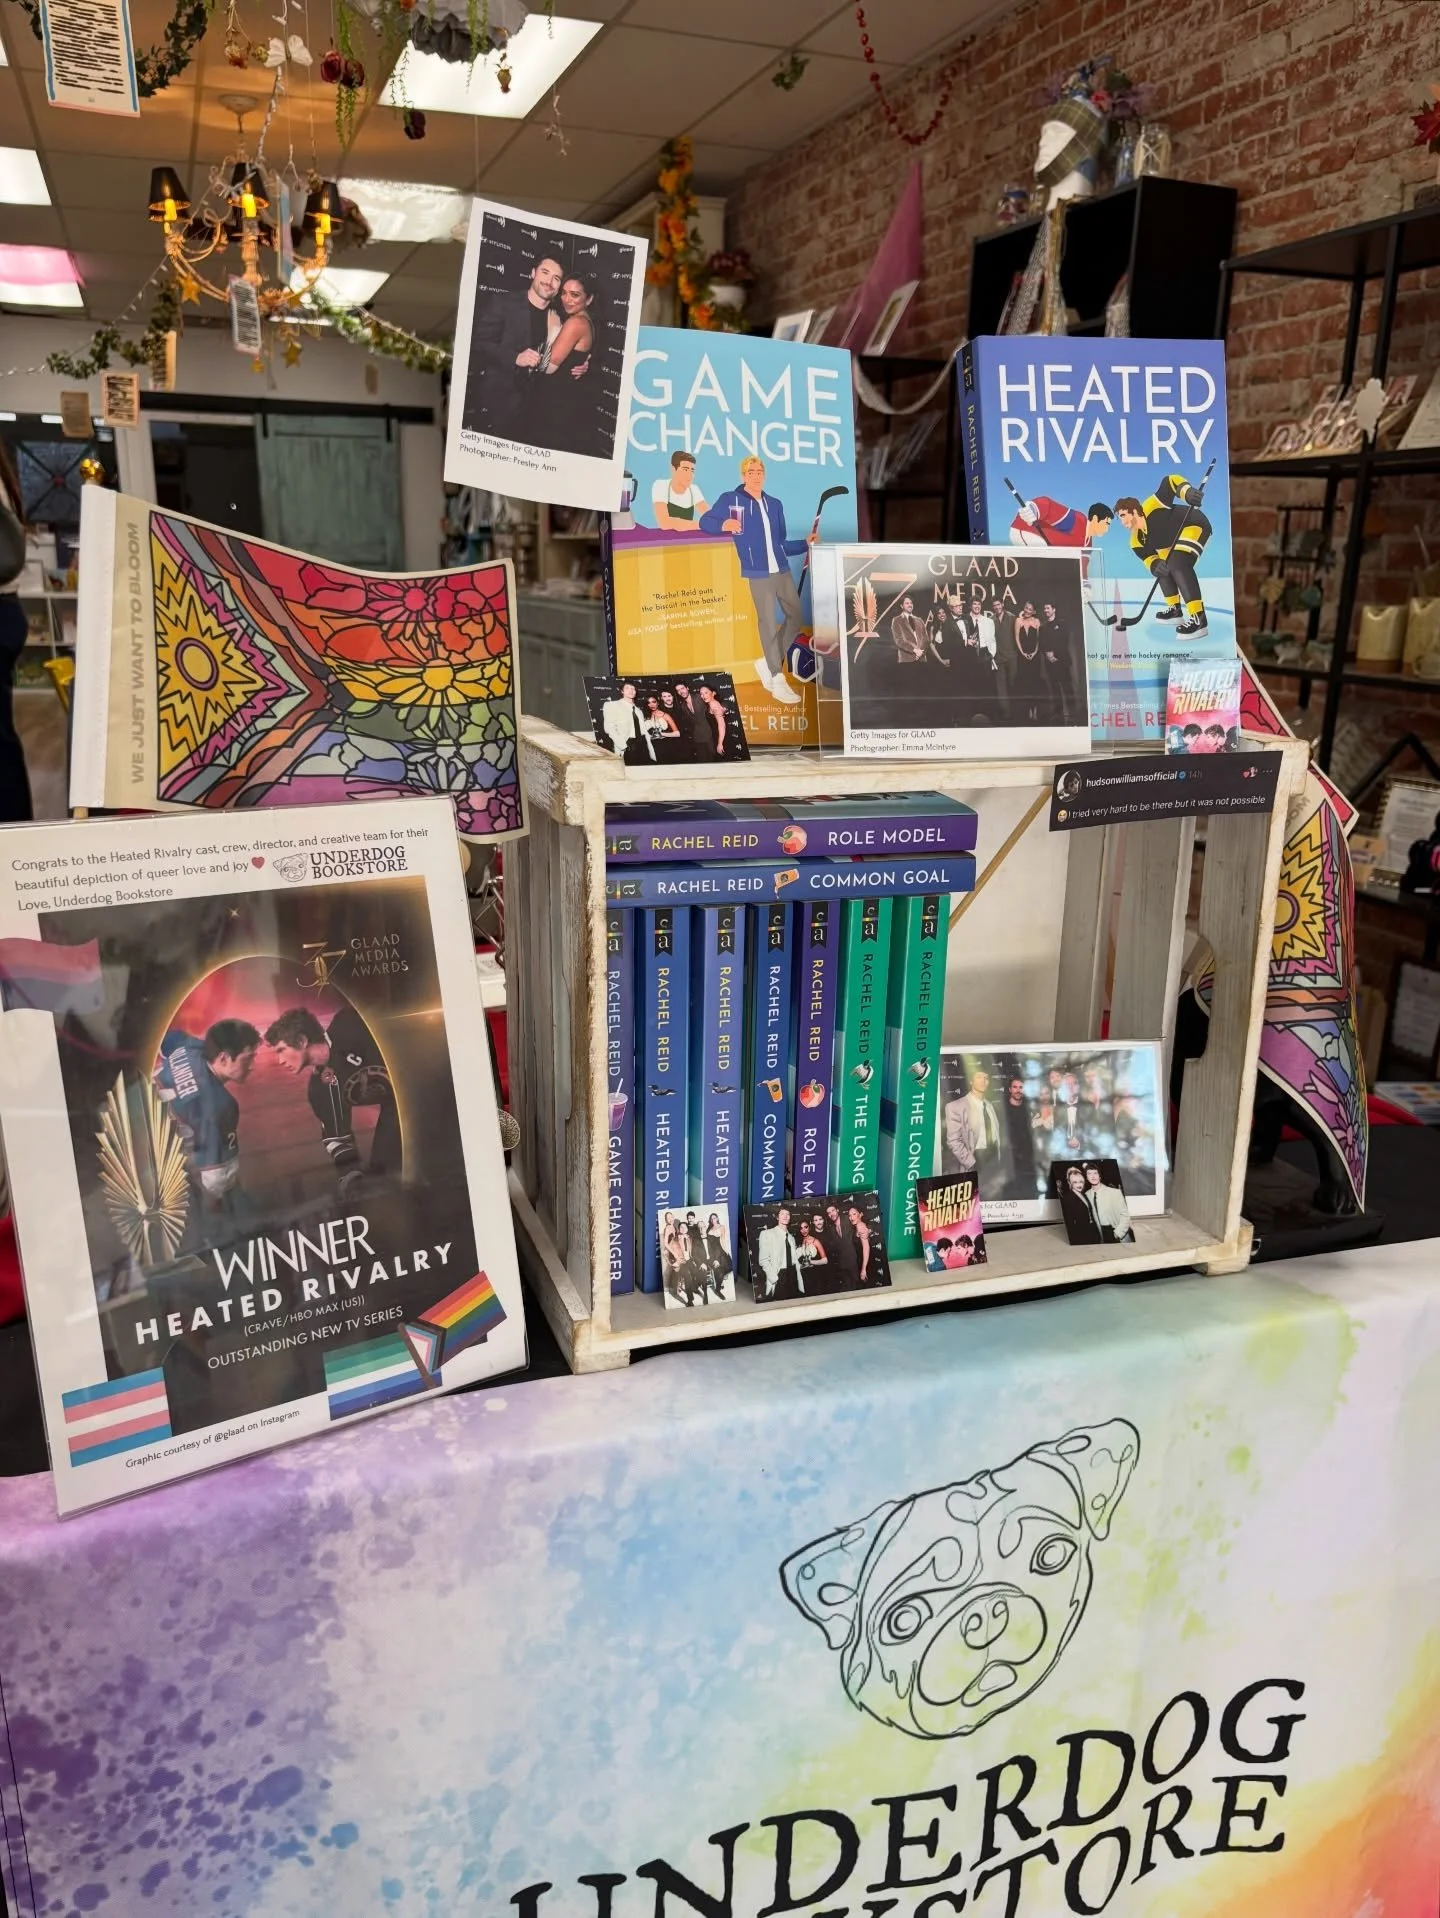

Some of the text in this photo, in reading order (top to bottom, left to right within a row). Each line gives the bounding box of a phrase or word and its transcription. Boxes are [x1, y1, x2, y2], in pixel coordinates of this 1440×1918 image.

[631, 349, 842, 424] GAME
[999, 364, 1217, 414] HEATED
[460, 431, 551, 458] Getty Images for GLAAD
[628, 411, 845, 467] CHANGER
[1001, 417, 1216, 465] RIVALRY
[459, 444, 557, 472] Photographer: Presley Ann
[968, 405, 981, 514] RACHEL REID
[928, 555, 1019, 578] GLAAD
[681, 588, 697, 598] Reid
[128, 522, 145, 785] WE JUST WANT TO BLOOM
[1139, 651, 1160, 660] hockey
[745, 704, 782, 714] Bestselling
[768, 715, 809, 731] REID
[850, 730, 937, 740] Getty Images for GLAAD
[902, 743, 924, 752] Emma
[1086, 770, 1178, 788] hudsonwilliamsofficial
[1073, 807, 1090, 819] tried
[1091, 806, 1108, 819] very
[1109, 803, 1128, 814] hard
[1130, 804, 1138, 813] to
[1140, 801, 1151, 811] be
[1152, 799, 1174, 811] there
[1175, 798, 1189, 808] but
[1190, 797, 1196, 808] it
[1198, 798, 1214, 806] was
[1216, 795, 1229, 806] not
[1231, 795, 1266, 807] possible
[12, 828, 429, 872] Congrats to the Heated Rivalry cast, crew, director, and creative team for their
[310, 845, 406, 866] UNDERDOG
[651, 836, 715, 851] RACHEL
[721, 833, 759, 849] REID
[828, 830, 875, 846] ROLE
[882, 827, 947, 844] MODEL
[15, 875, 69, 892] beautiful
[73, 872, 128, 887] depiction
[131, 869, 143, 881] of
[147, 868, 178, 880] queer
[183, 866, 206, 876] love
[209, 861, 230, 873] and
[312, 858, 409, 879] BOOKSTORE
[657, 869, 950, 895] RACHEL REID COMMON GOAL
[18, 886, 173, 912] Love, Underdog Bookstore
[350, 933, 400, 950] GLAAD
[354, 947, 400, 963] MEDIA
[351, 960, 409, 977] AWARDS
[657, 967, 670, 1030] RACHEL
[719, 966, 731, 1028] RACHEL
[810, 959, 824, 1020] RACHEL
[657, 1036, 670, 1073] REID
[718, 1034, 730, 1070] REID
[808, 1026, 821, 1062] REID
[762, 965, 781, 1199] RACHEL REID COMMON
[852, 953, 874, 1185] RACHEL REID THE LONG
[903, 951, 933, 1237] RACHEL REID THE LONG GAME
[608, 971, 622, 1280] RACHEL REID GAME CHANGER
[656, 1112, 670, 1183] HEATED
[716, 1110, 730, 1179] HEATED
[802, 1127, 817, 1174] ROLE
[926, 1180, 973, 1211] HEATED
[924, 1198, 976, 1233] RIVALRY
[212, 1215, 376, 1291] WINNER
[135, 1242, 452, 1345] HEATED RIVALRY
[244, 1308, 313, 1337] (CRAVE/HBO
[315, 1301, 340, 1317] MAX
[207, 1305, 404, 1370] OUTSTANDING NEW TV SERIES
[125, 1410, 300, 1470] Graphic courtesy of @glaad on Instagram
